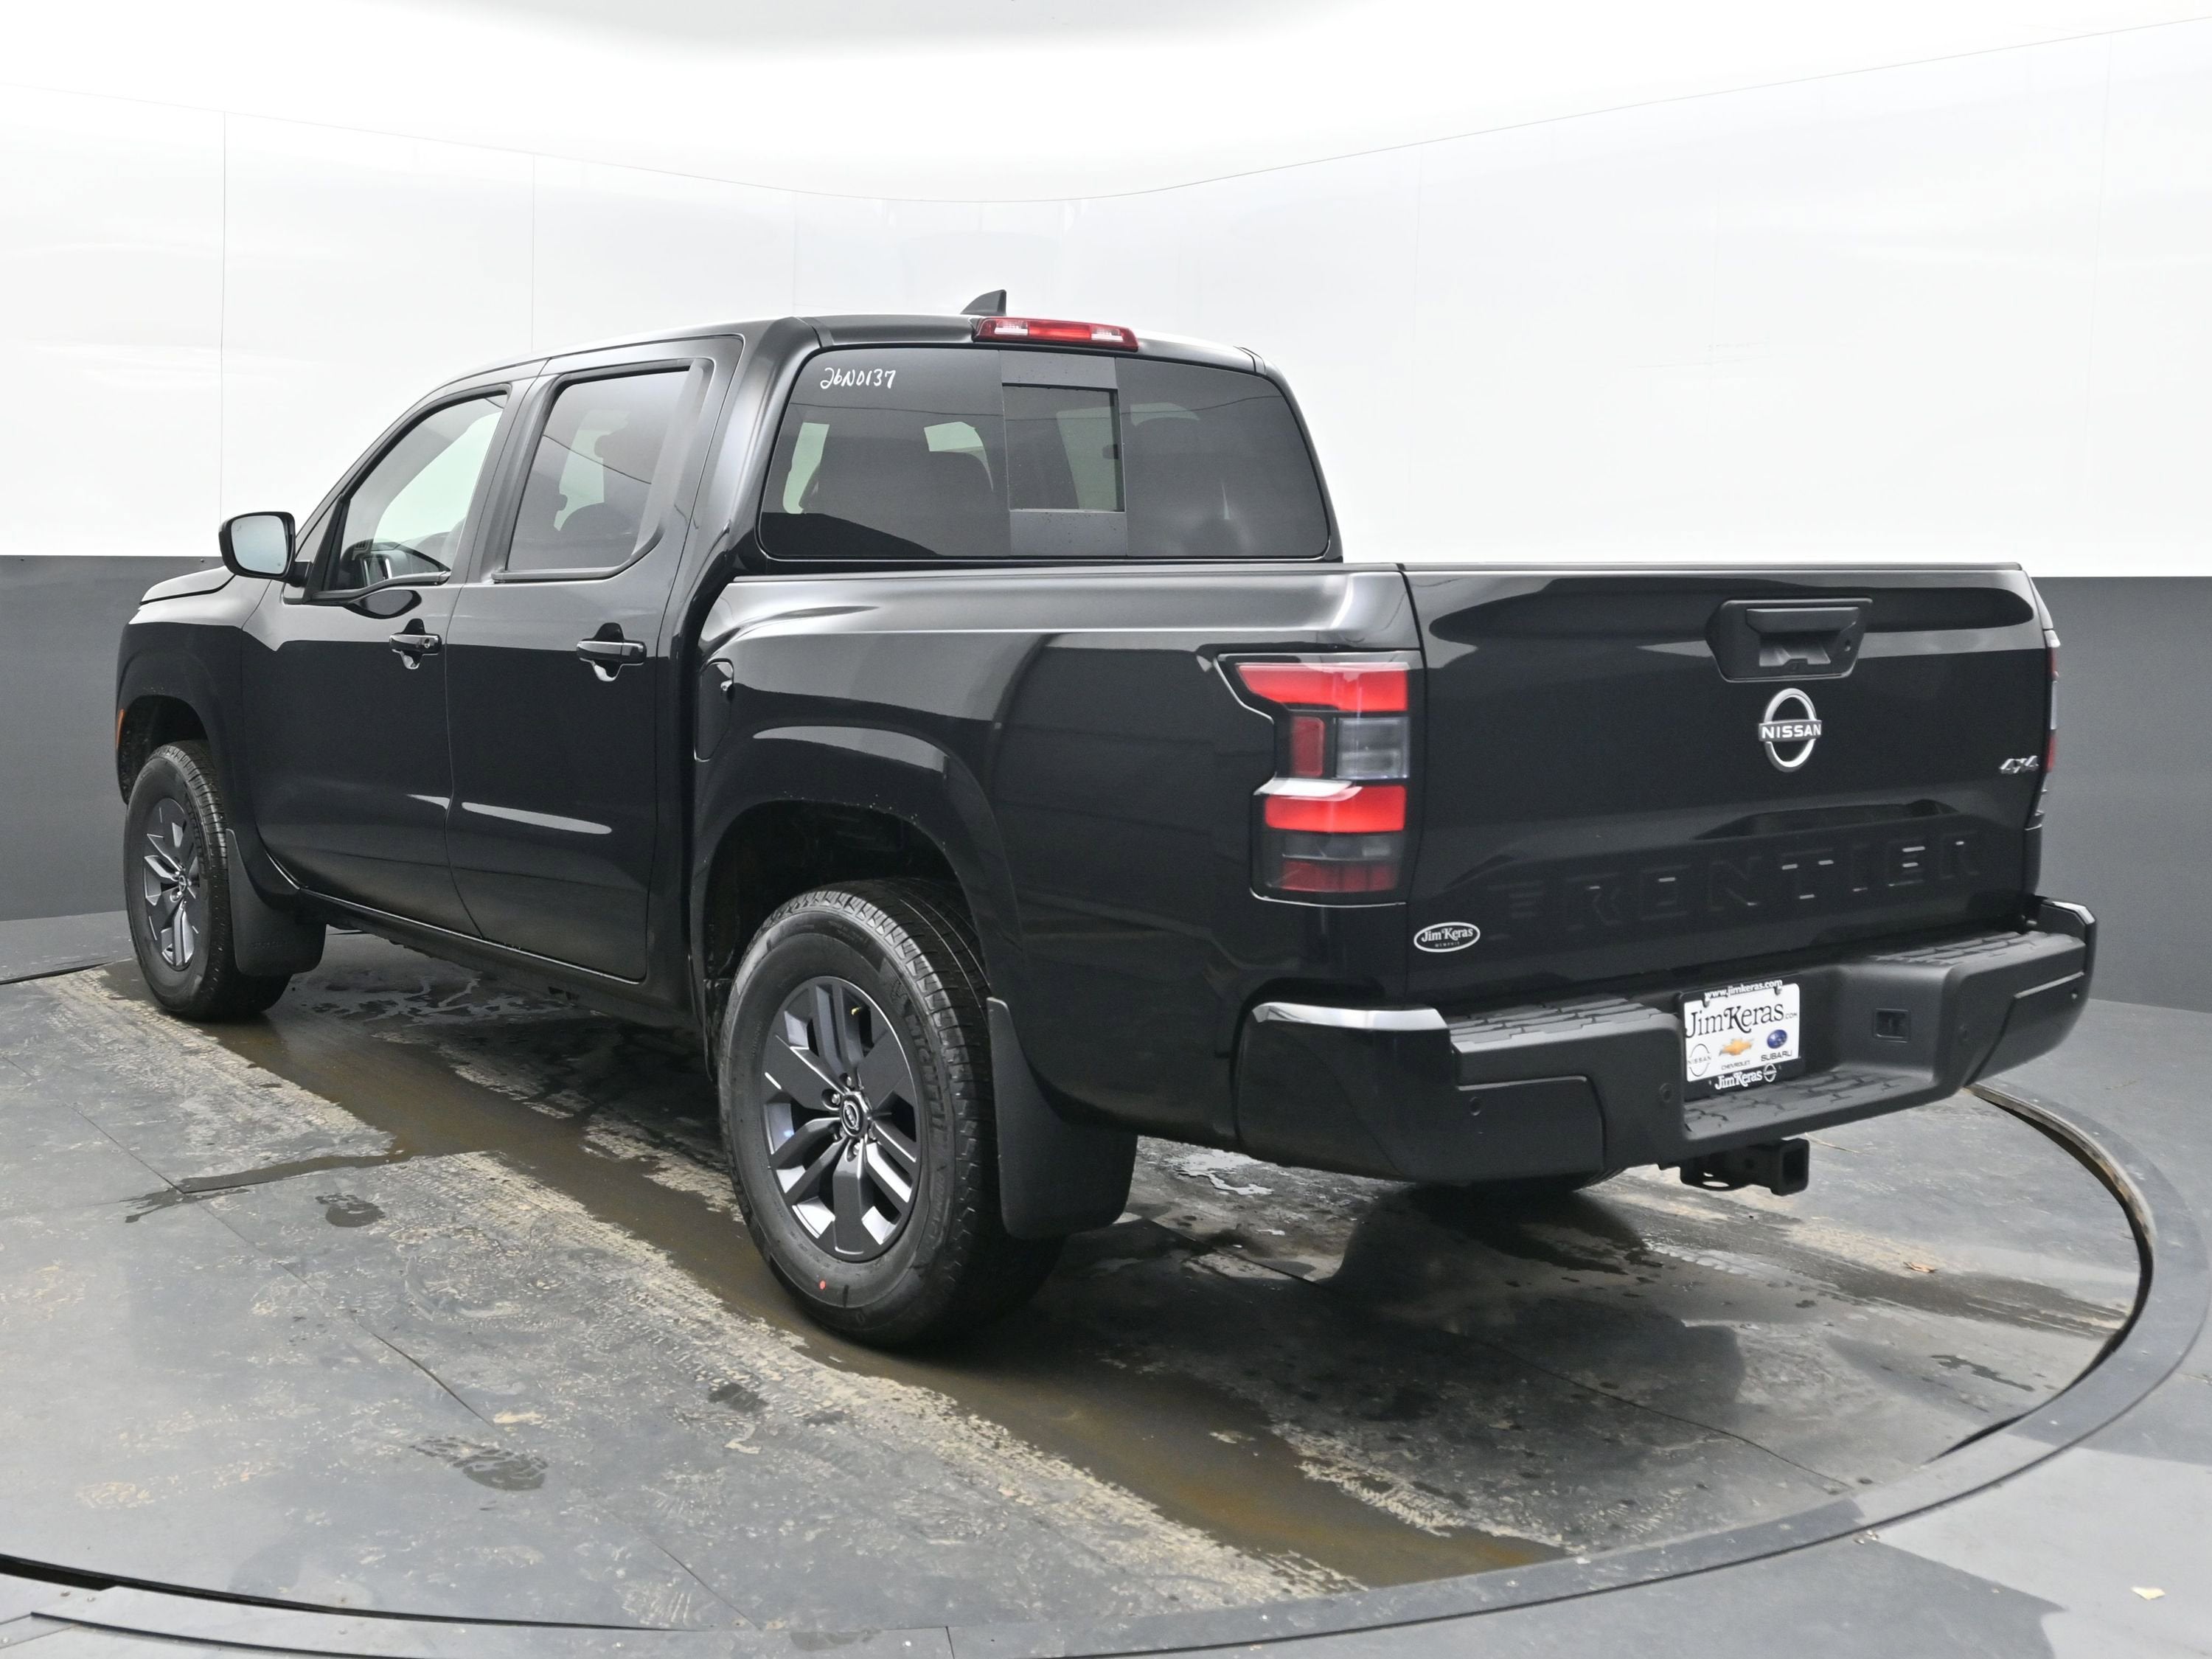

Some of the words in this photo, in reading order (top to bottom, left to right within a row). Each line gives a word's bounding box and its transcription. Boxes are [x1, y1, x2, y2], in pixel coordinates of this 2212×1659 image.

[820, 367, 896, 389] 26N0137
[1761, 723, 1821, 738] NISSAN
[1705, 979, 1783, 998] www.jimkeras.com
[1687, 1054, 1711, 1065] NISSAN
[1761, 1051, 1792, 1062] SUBARU
[1721, 1060, 1750, 1071] CHEVROLET
